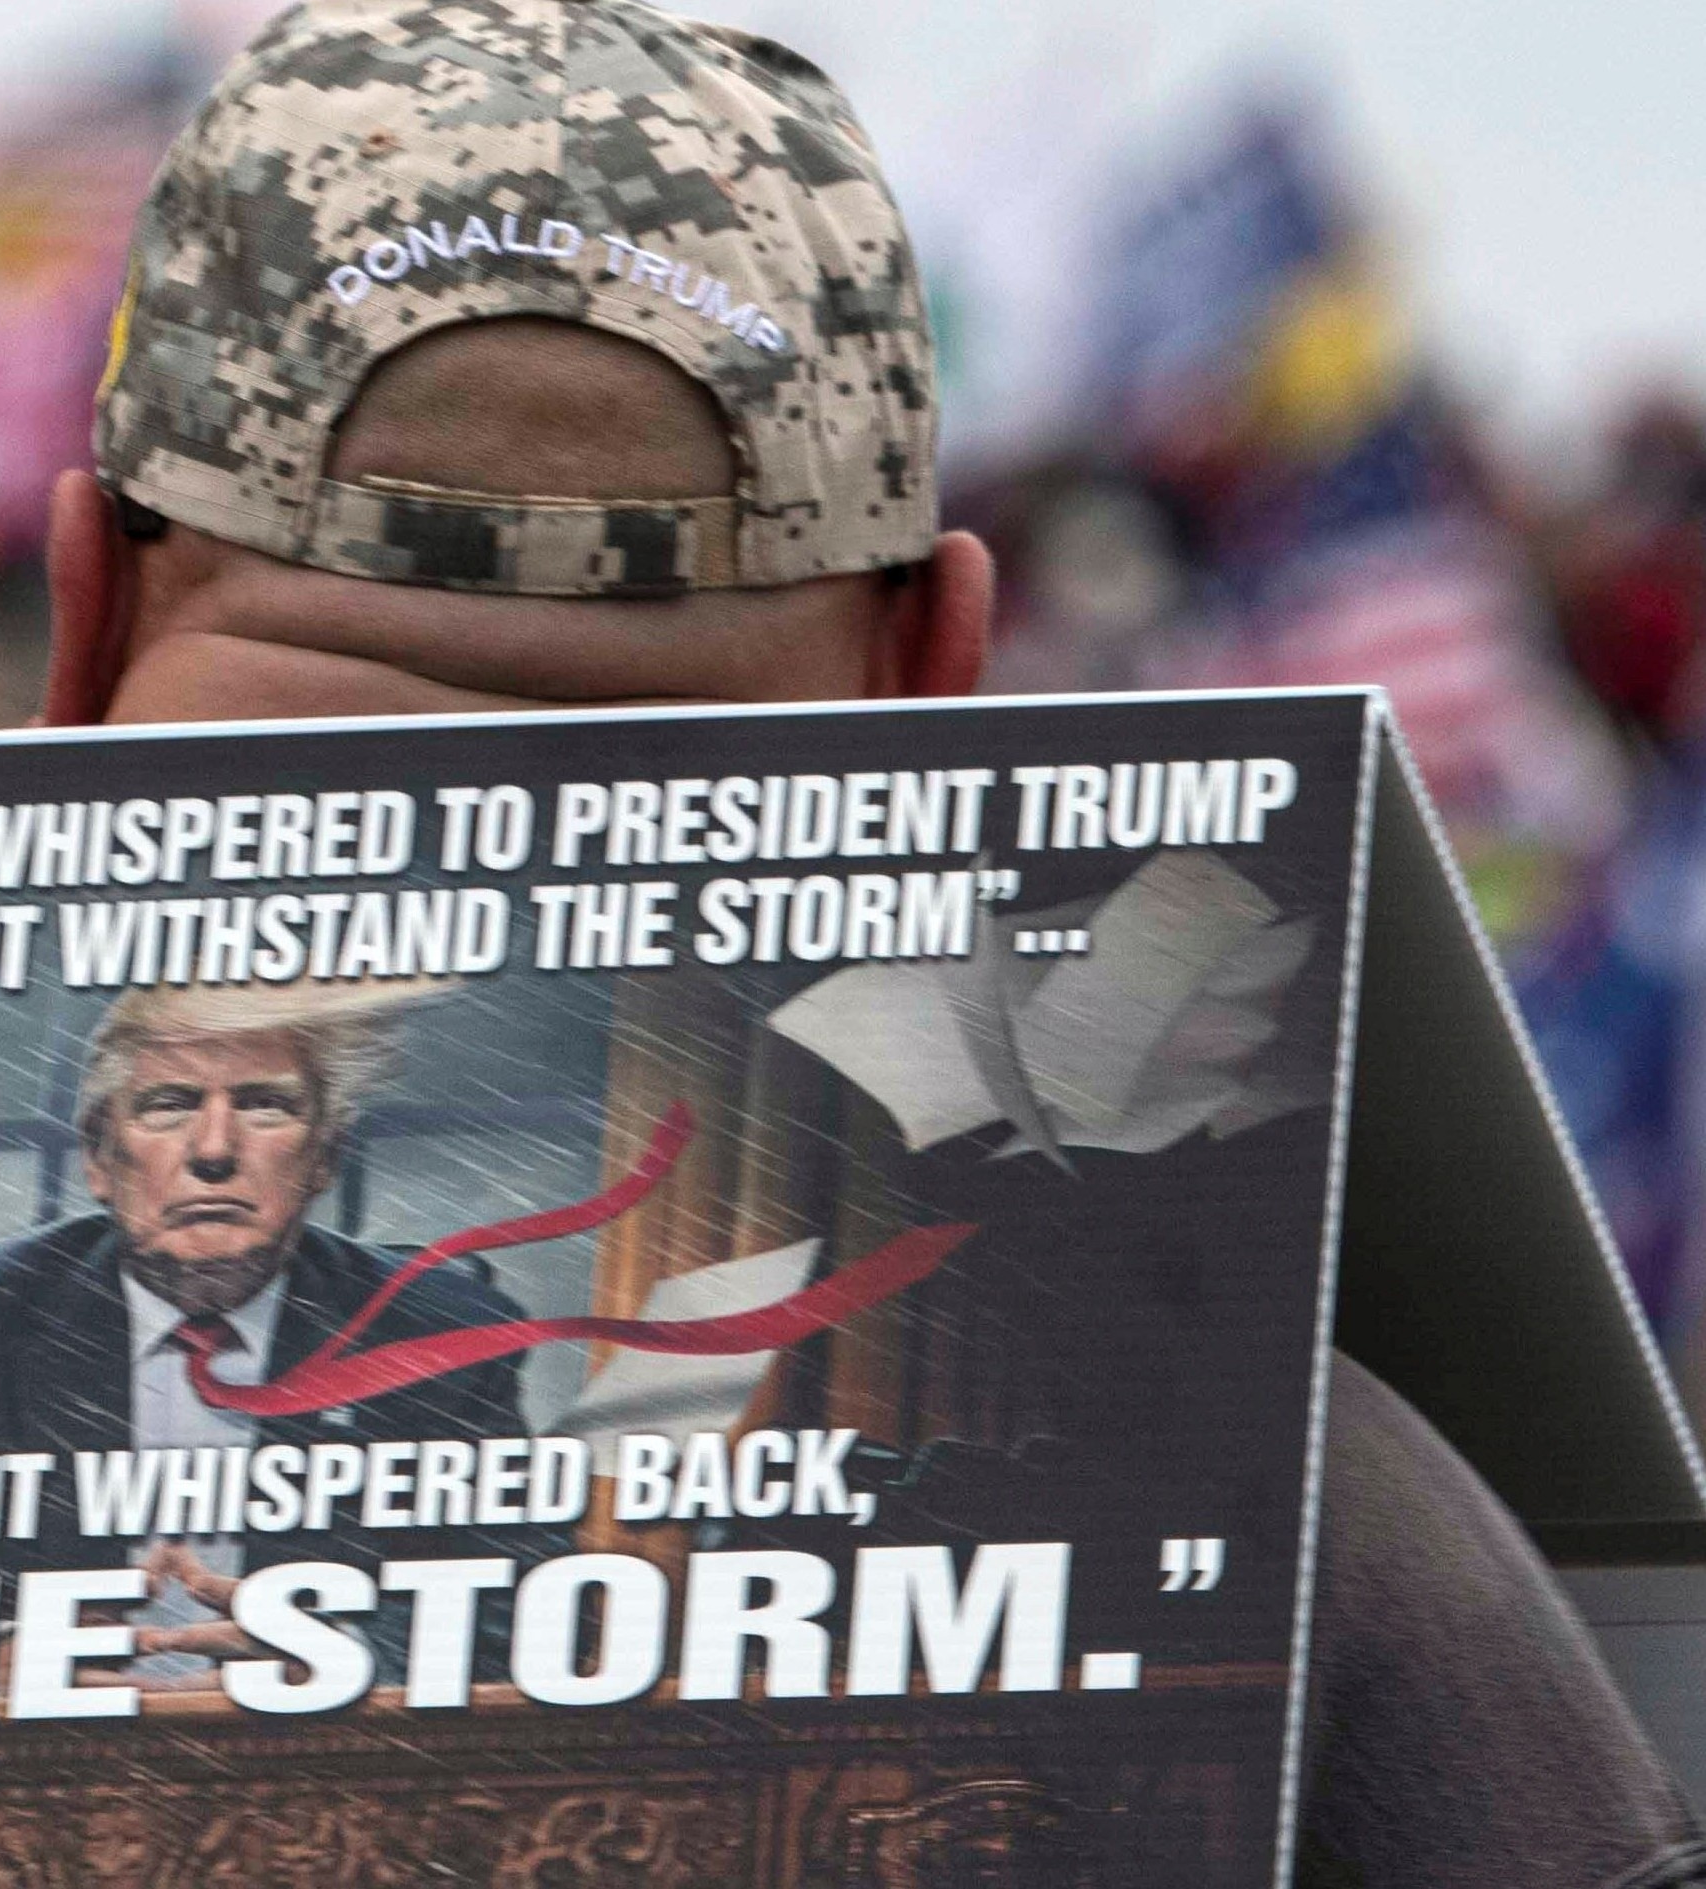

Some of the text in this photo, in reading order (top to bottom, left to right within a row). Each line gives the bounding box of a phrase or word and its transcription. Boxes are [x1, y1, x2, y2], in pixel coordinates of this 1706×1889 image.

[327, 214, 785, 353] DONALD TRUMP
[435, 784, 536, 872] TO
[552, 768, 996, 867] PRESIDENT
[1011, 757, 1299, 852] TRUMP
[59, 888, 511, 987] WITHSTAND
[531, 881, 679, 971] THE
[75, 1436, 587, 1538] WHISPERED
[614, 1428, 877, 1526] BACK,
[220, 1538, 1226, 1714] STORM.”
